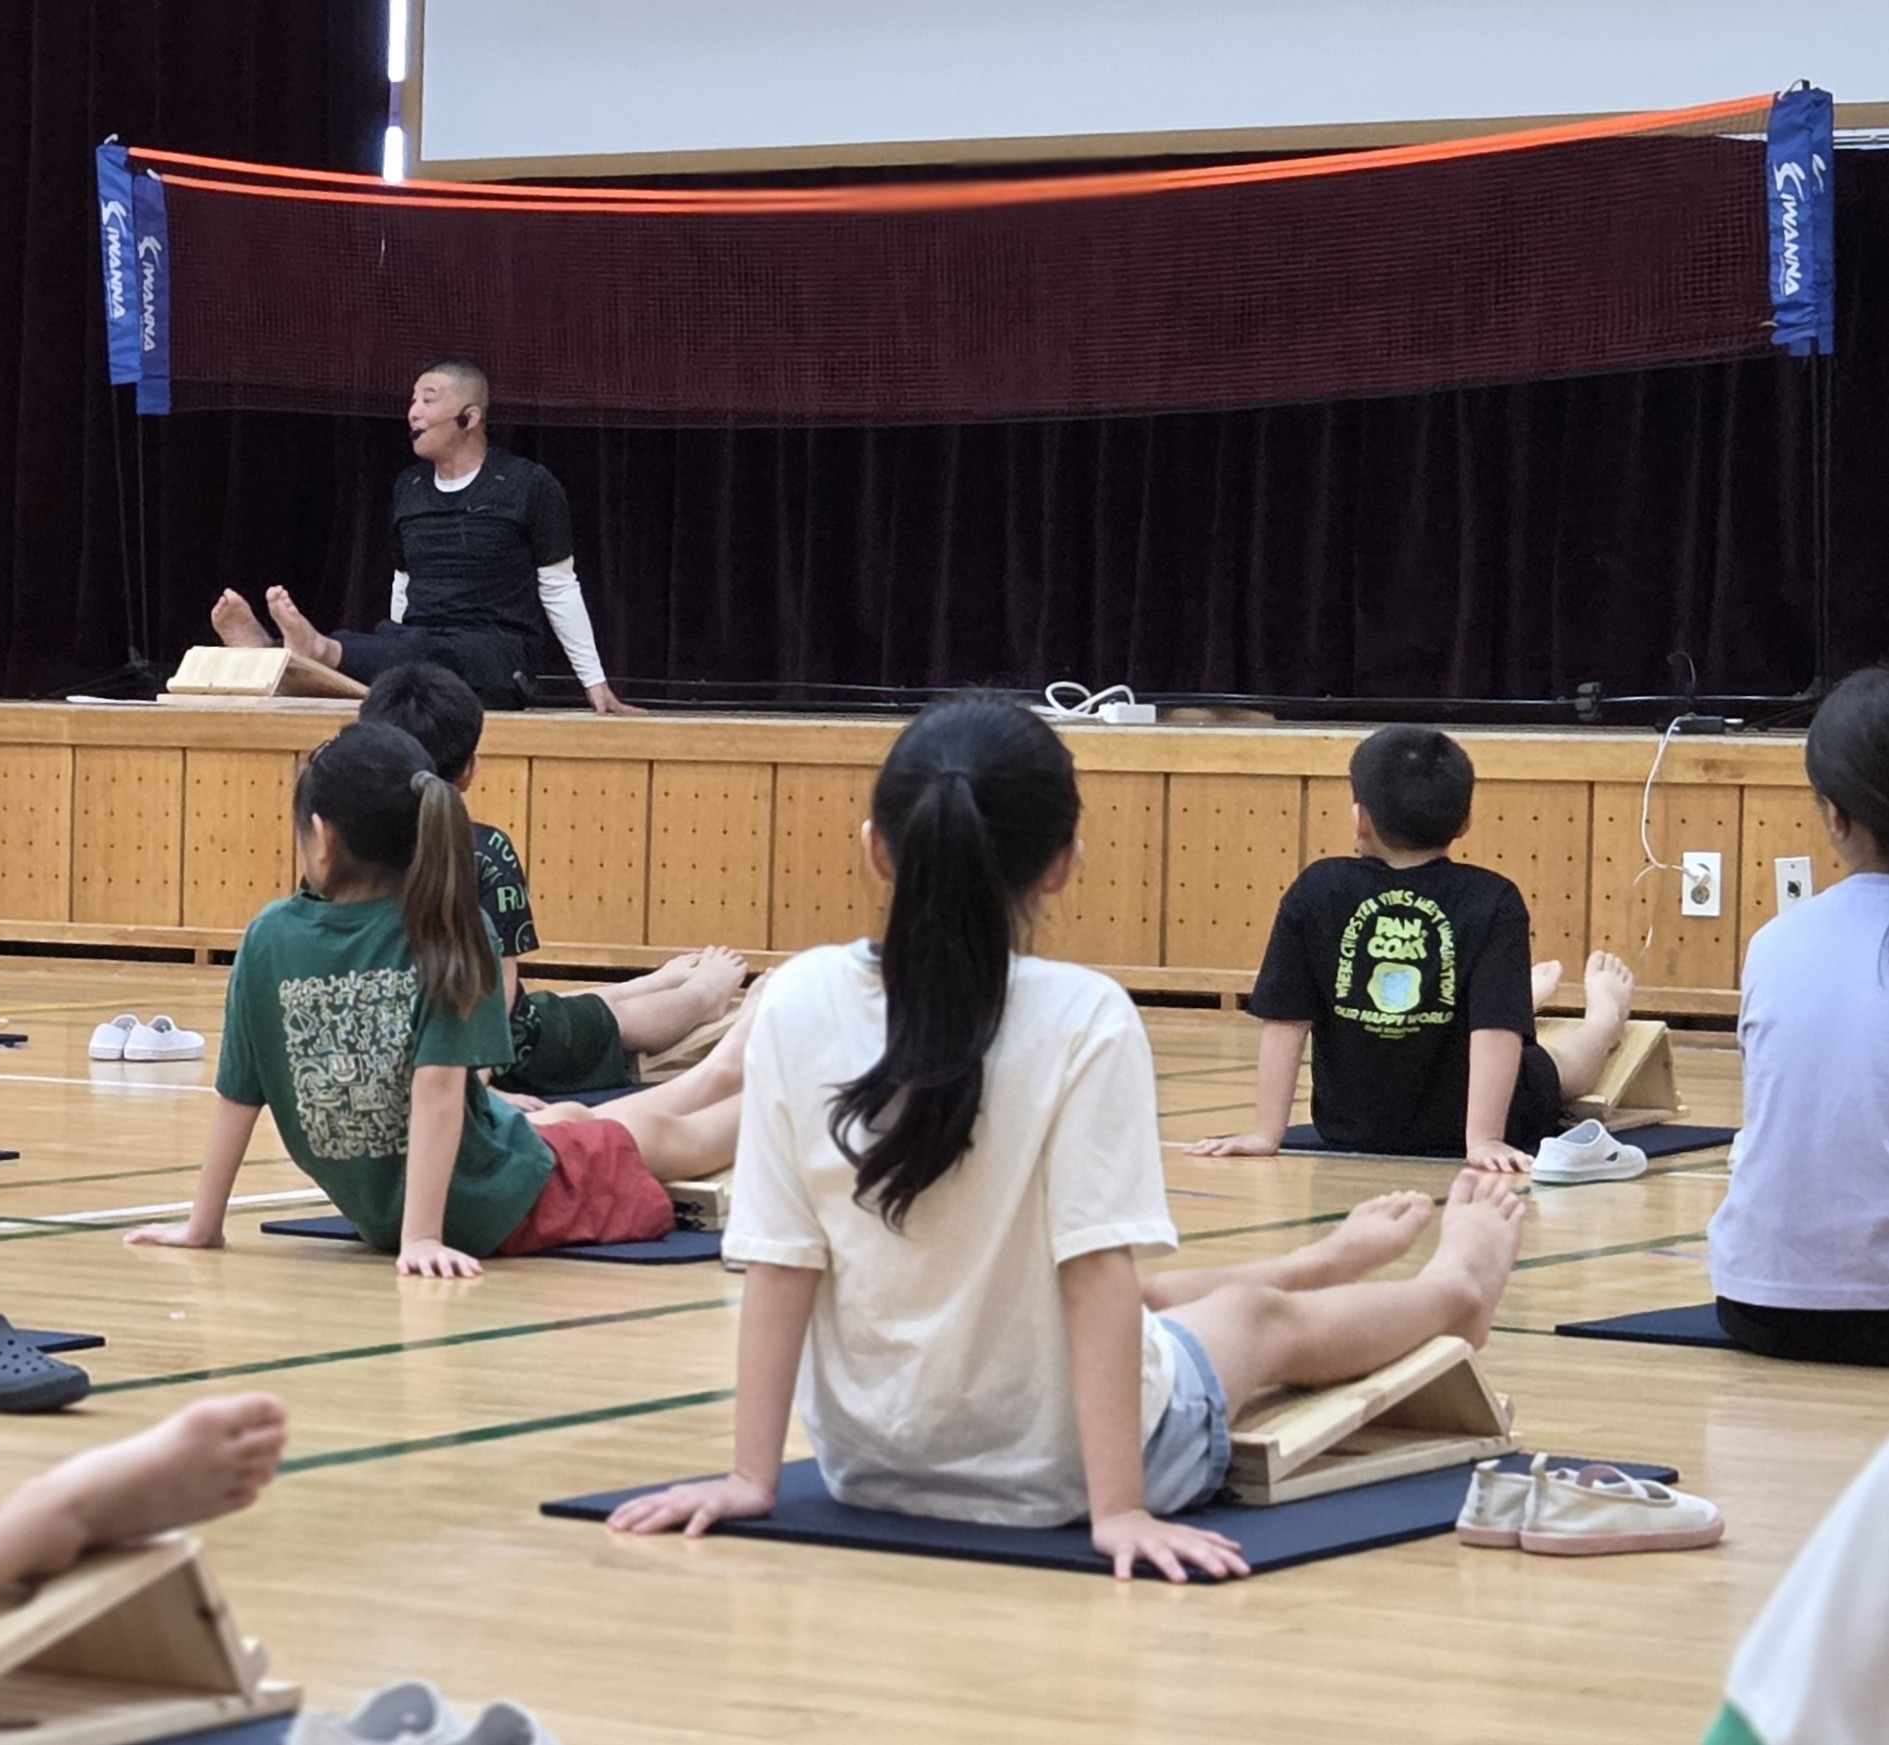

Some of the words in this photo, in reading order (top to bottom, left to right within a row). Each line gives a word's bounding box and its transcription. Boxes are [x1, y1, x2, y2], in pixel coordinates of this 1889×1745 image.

[1375, 916, 1422, 938] PAN
[1367, 936, 1428, 960] COAT
[1334, 1005, 1360, 1020] OUR
[1359, 1010, 1406, 1026] HAPPY
[1407, 1011, 1454, 1024] WORLD
